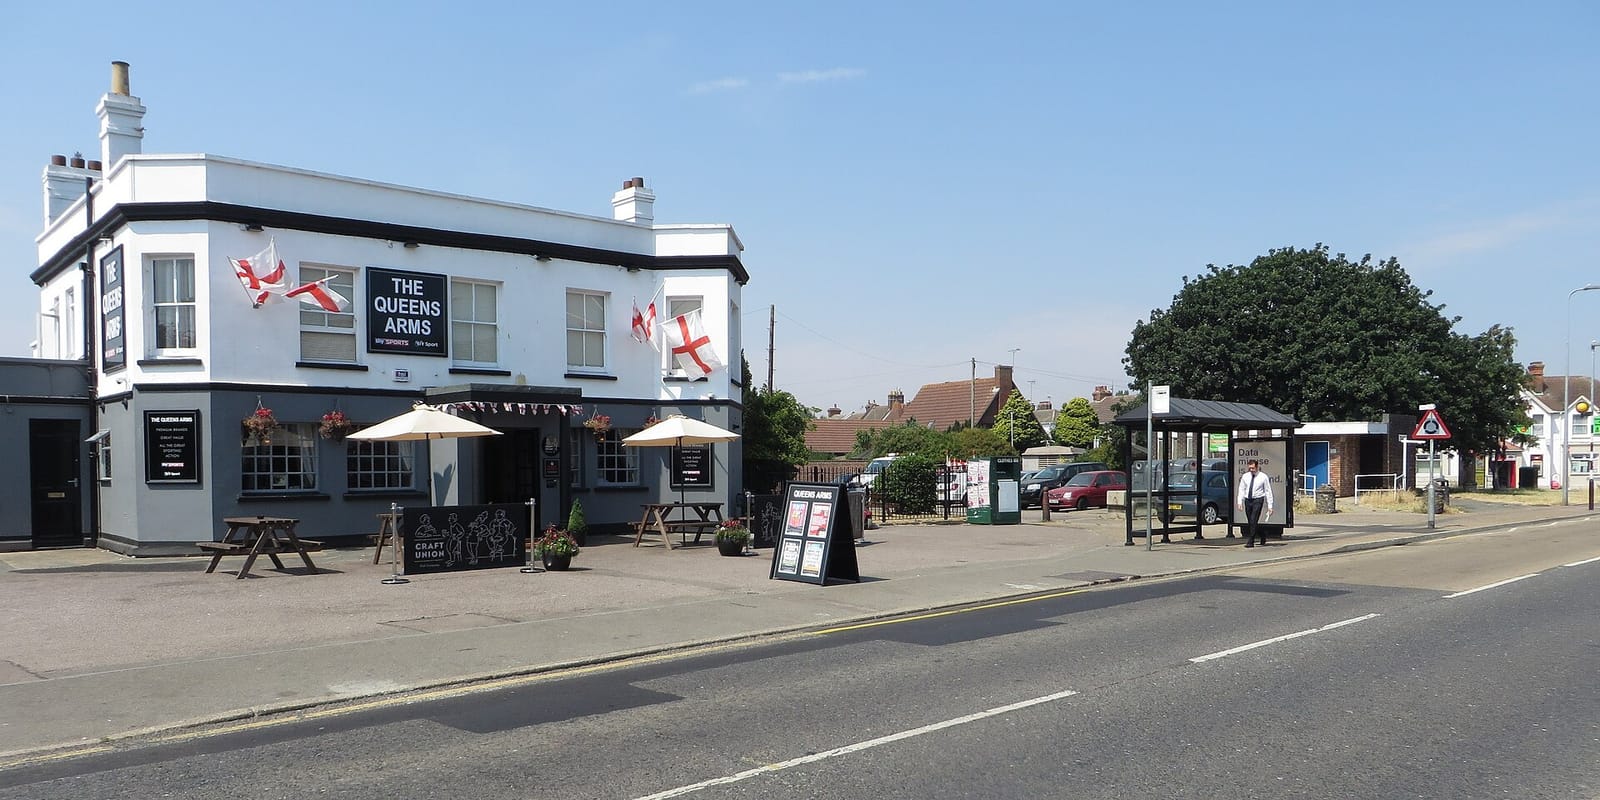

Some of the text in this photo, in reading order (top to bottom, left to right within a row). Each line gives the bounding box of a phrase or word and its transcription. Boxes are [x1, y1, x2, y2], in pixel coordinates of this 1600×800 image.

[391, 277, 424, 296] THE
[102, 286, 122, 315] QUEENS
[374, 296, 441, 317] QUEENS
[384, 317, 432, 336] ARMS
[1238, 449, 1259, 457] Data
[793, 489, 833, 500] QUEENS ARMS
[415, 541, 445, 550] CRAFT
[415, 550, 445, 559] UNION
